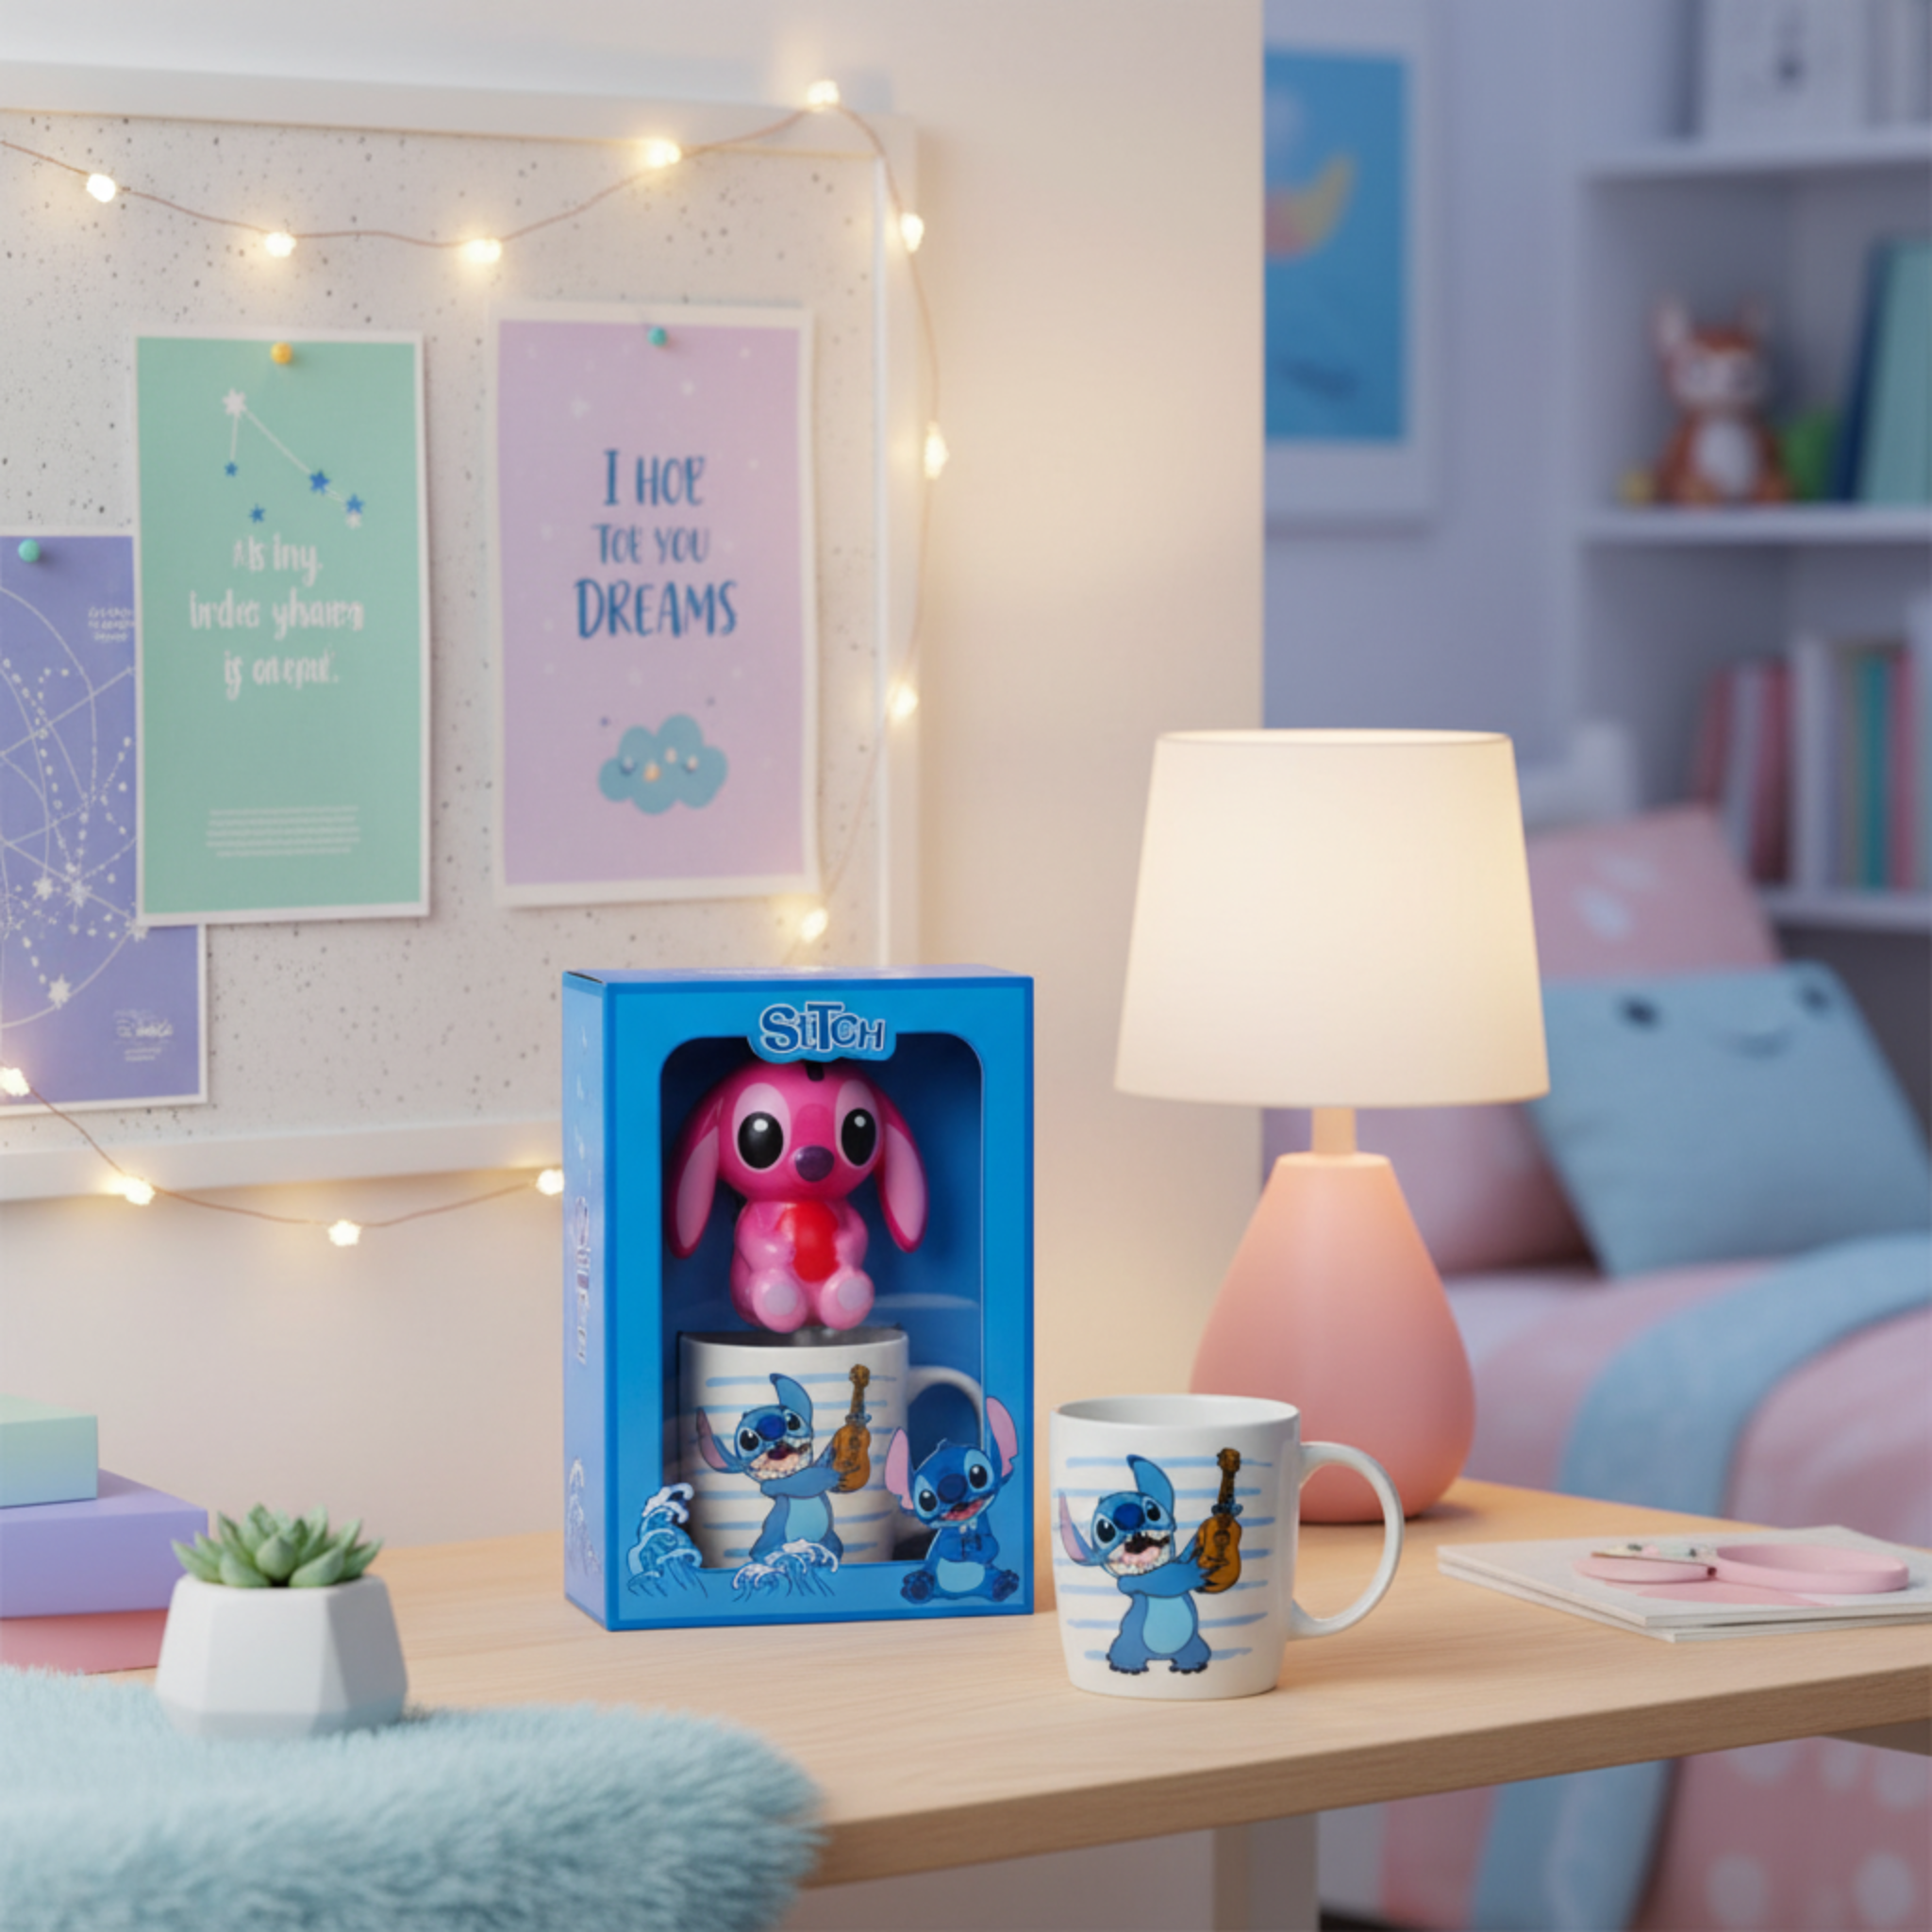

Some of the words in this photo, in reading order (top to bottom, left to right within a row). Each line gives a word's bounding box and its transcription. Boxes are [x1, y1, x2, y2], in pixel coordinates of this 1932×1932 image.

[603, 448, 619, 507] I
[654, 525, 709, 565] YOU
[574, 576, 738, 641] DREAMS
